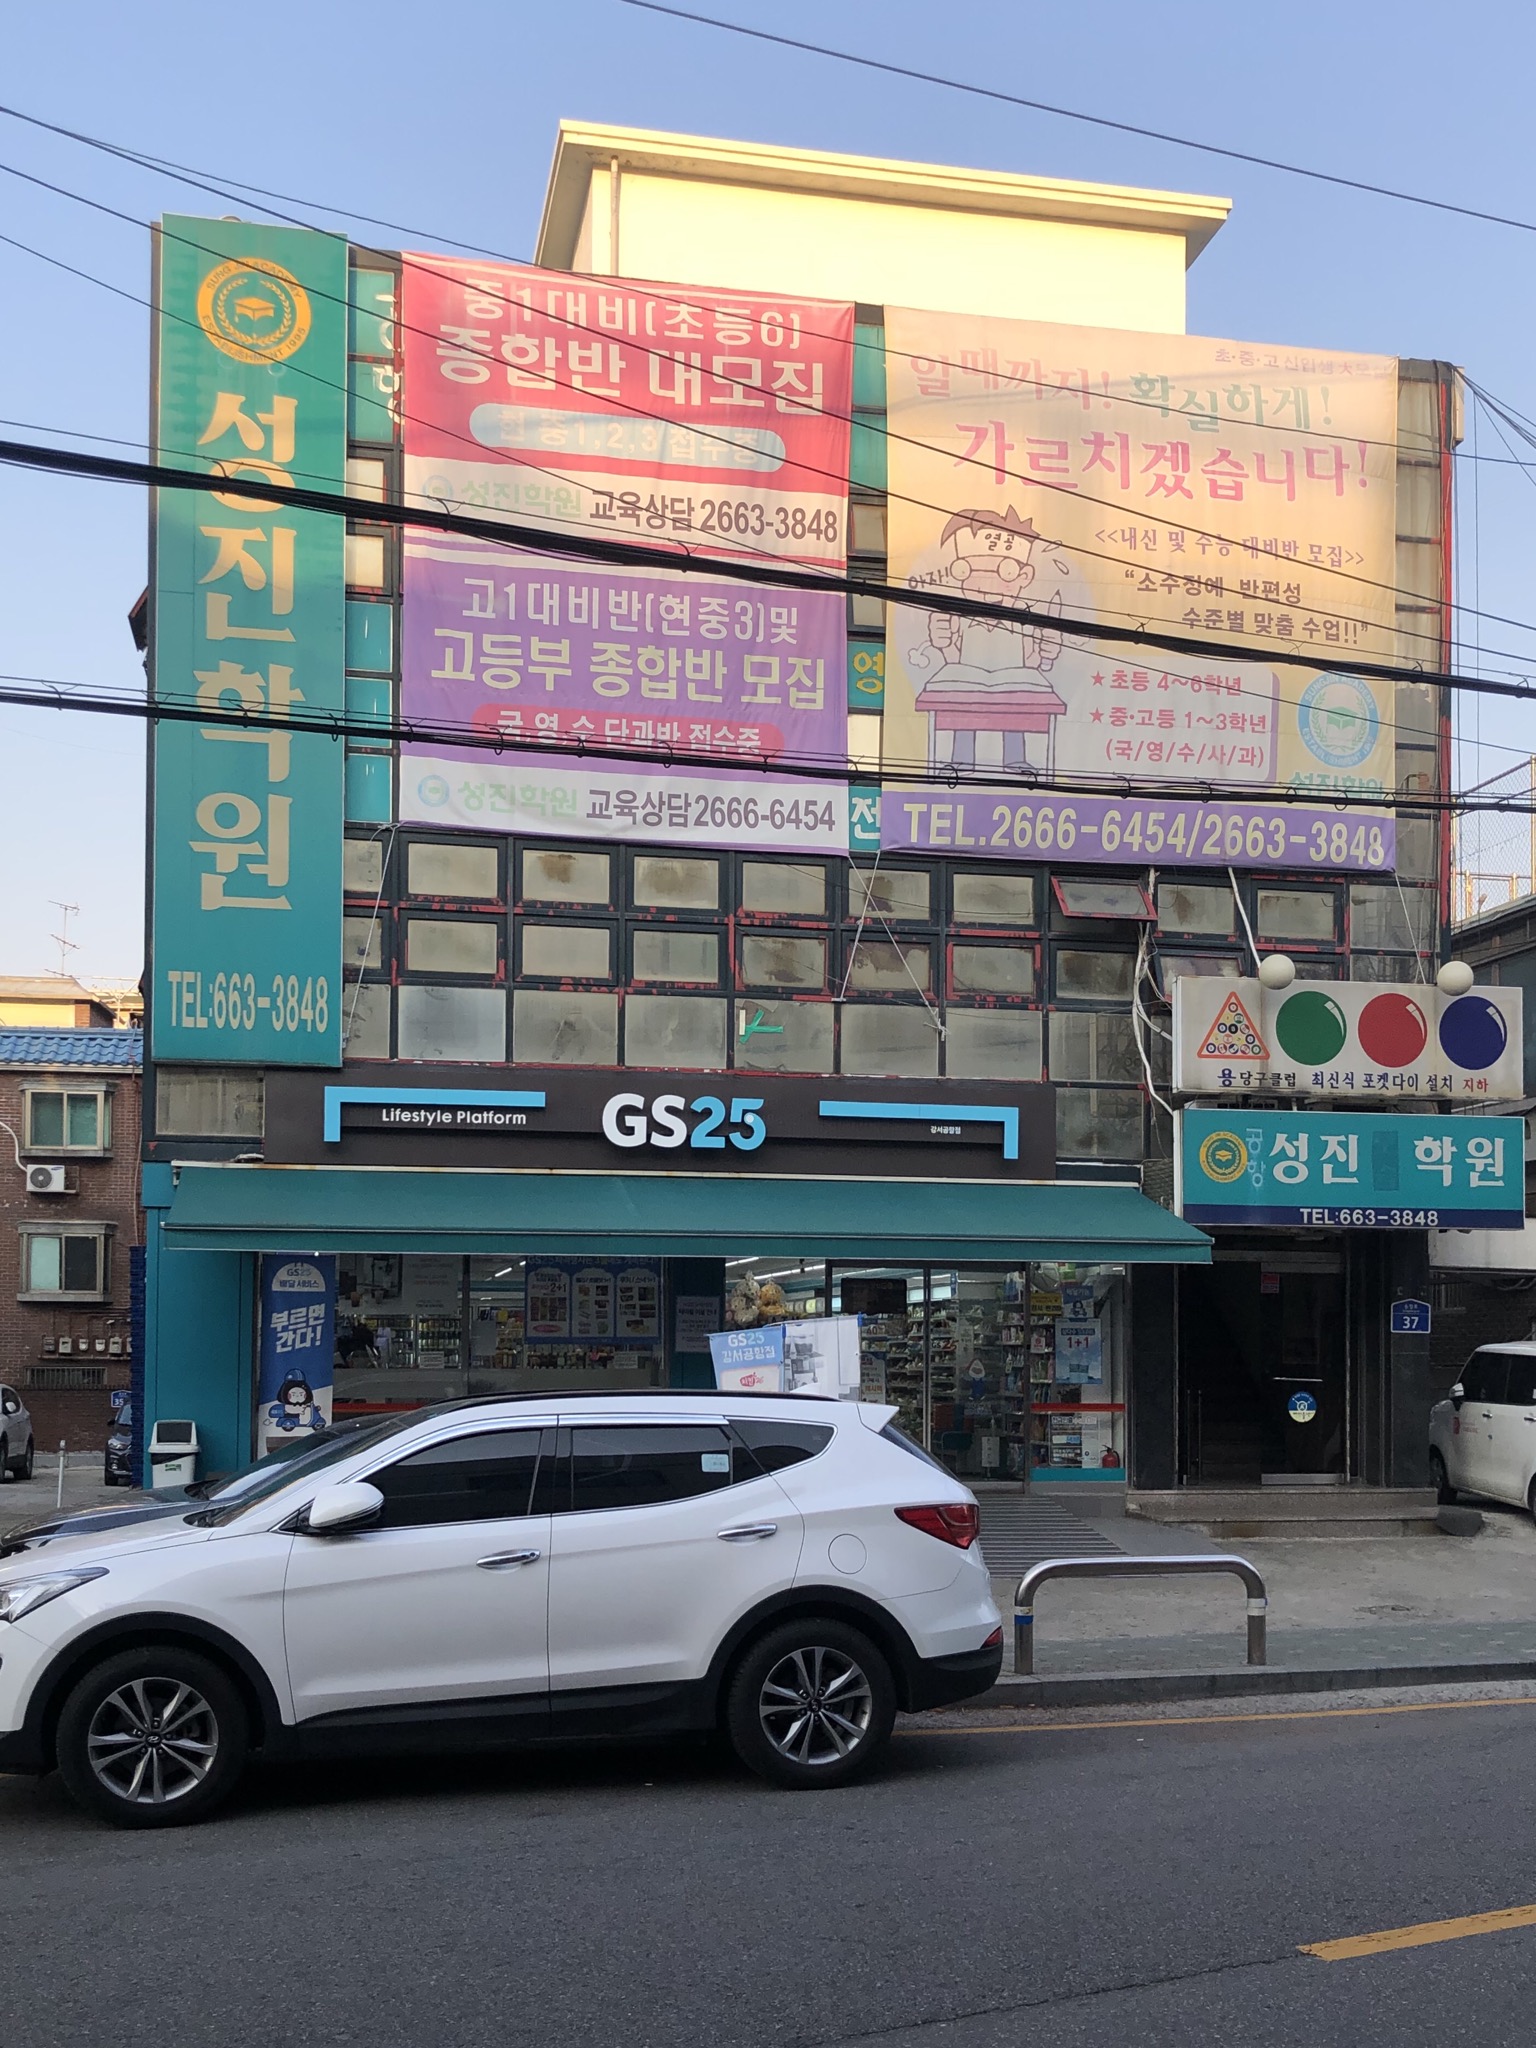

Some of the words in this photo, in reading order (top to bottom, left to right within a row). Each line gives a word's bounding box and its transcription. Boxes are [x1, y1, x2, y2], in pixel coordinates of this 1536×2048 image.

[436, 324, 627, 397] 종합반
[649, 347, 824, 416] 대모집
[1128, 373, 1331, 434] 확실하게!
[669, 426, 758, 465] 접수중
[954, 419, 1368, 502] 가르치겠습니다!
[461, 479, 582, 518] 성진학원
[590, 490, 695, 532] 교육상담
[700, 499, 839, 543] 2663-3848
[984, 532, 1015, 551] 열공
[1168, 528, 1185, 553] 및
[1195, 533, 1234, 557] 수능
[1241, 536, 1300, 561] 대비반
[907, 566, 949, 590] 아자!
[1239, 578, 1303, 605] 반편성
[1181, 607, 1246, 632] 수준별
[1253, 611, 1295, 637] 맞춤
[189, 391, 306, 911] 성진학원
[432, 628, 571, 691] 고등부
[590, 641, 727, 703] 종합반
[741, 655, 825, 710] 모집
[1109, 669, 1150, 693] 초등
[1105, 738, 1264, 769] (국/영/수/사/과)
[457, 778, 579, 818] 성진학원
[903, 803, 1386, 867] TEL.2666-6454/2663-3848
[167, 970, 329, 1034] TEL:663-3848
[1311, 1072, 1355, 1090] 최신식
[1426, 1074, 1453, 1092] 설치
[1462, 1077, 1489, 1094] 지하
[382, 1107, 453, 1126] Lifestyle
[456, 1109, 527, 1126] Platform
[601, 1092, 767, 1151] GS25
[1269, 1132, 1360, 1185] 성진
[1413, 1134, 1506, 1188] 학원
[1299, 1207, 1440, 1228] TEL:663-3848
[550, 1282, 567, 1293] 2+1
[270, 1303, 326, 1332] 부르면
[1402, 1316, 1419, 1330] 37
[276, 1325, 322, 1354] 간다!
[727, 1332, 765, 1348] GS25
[1066, 1336, 1090, 1349] 1+1
[113, 1398, 124, 1406] 35
